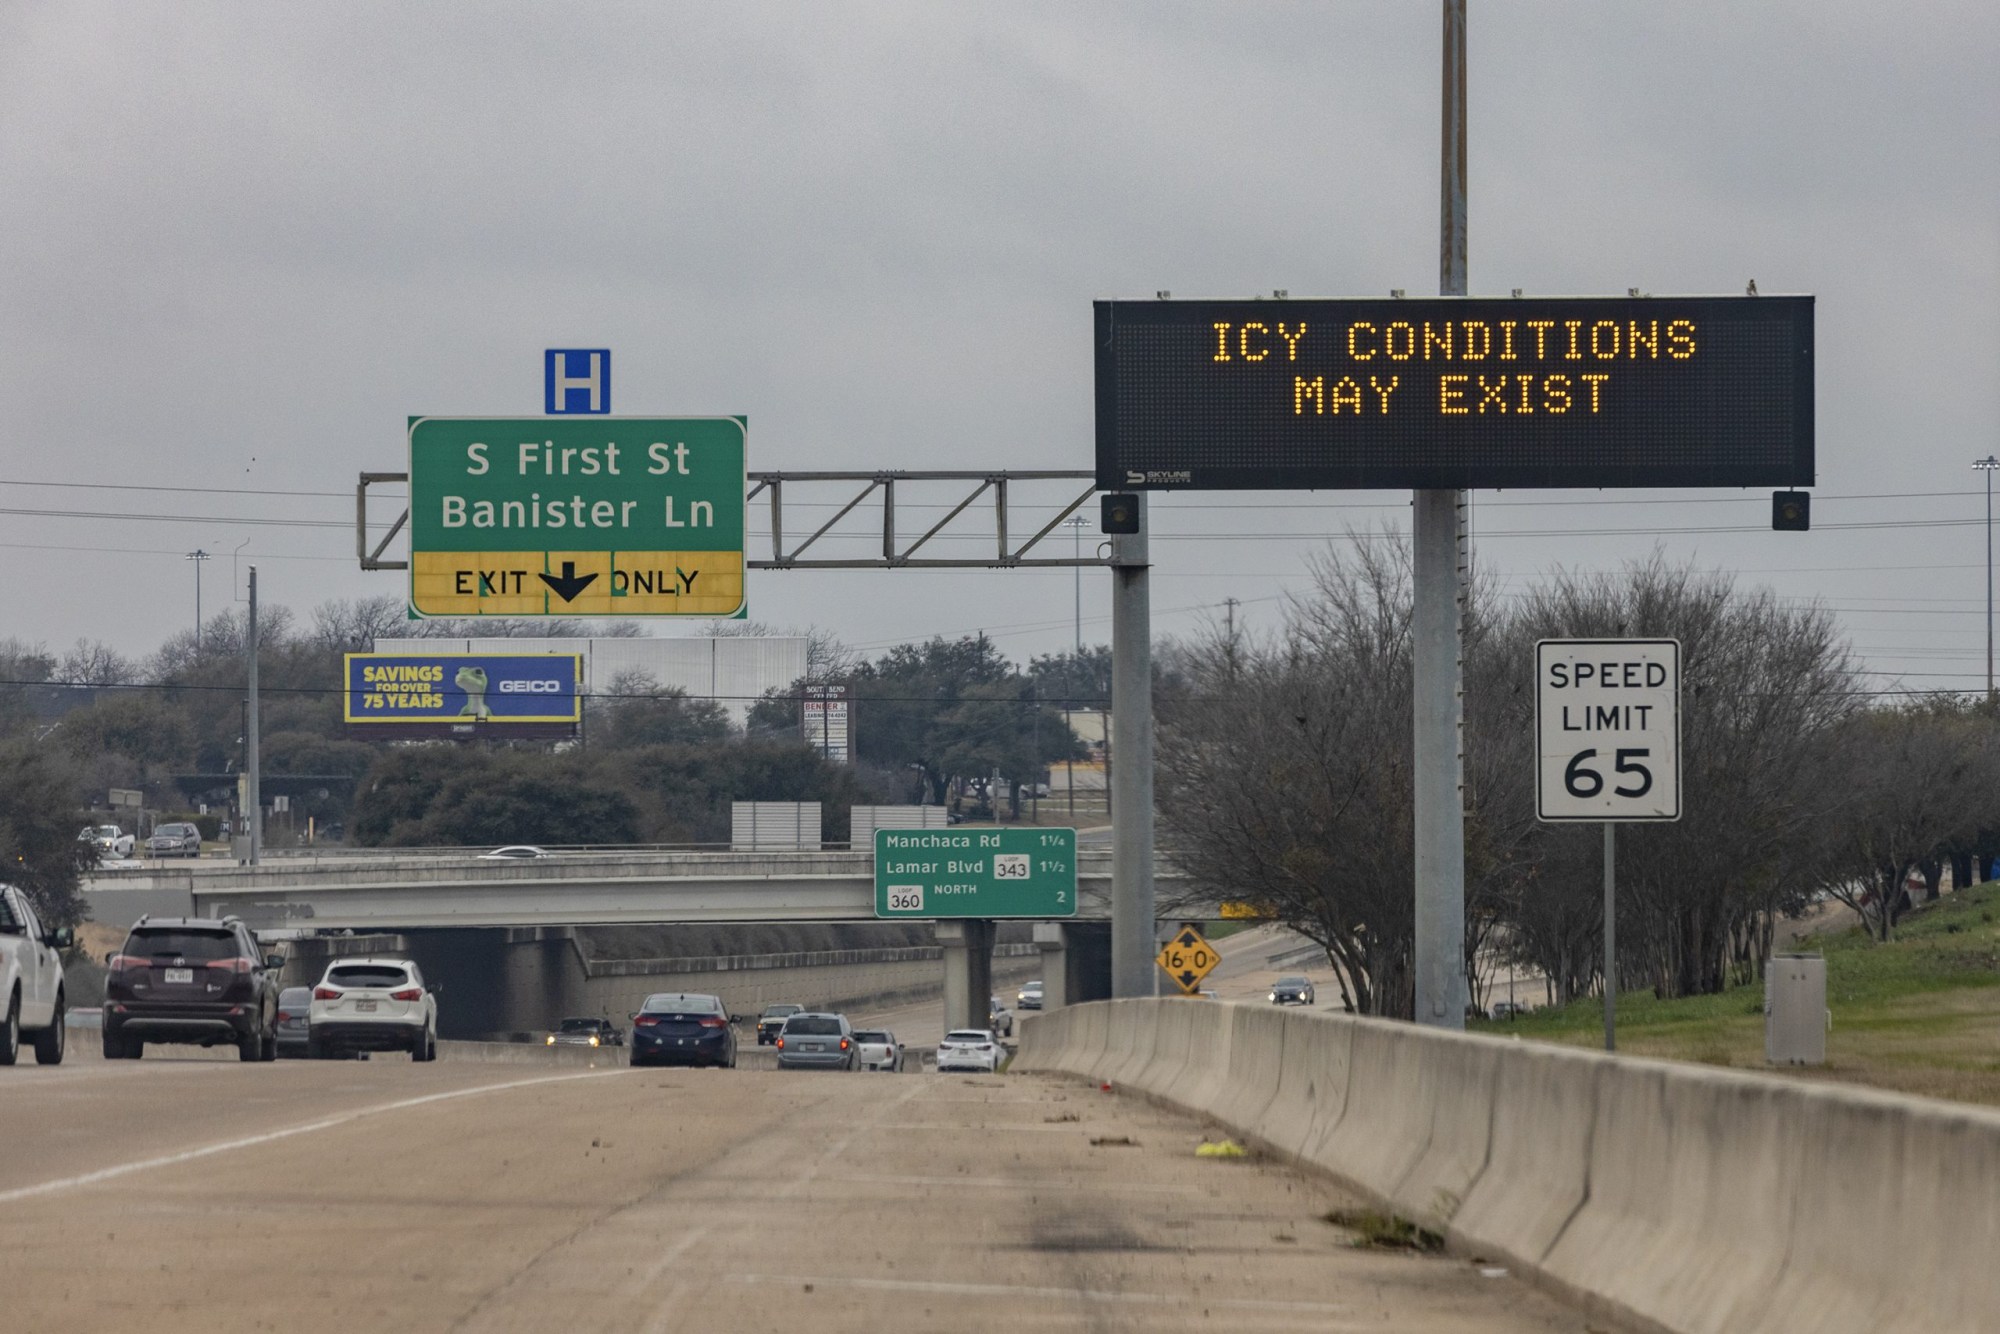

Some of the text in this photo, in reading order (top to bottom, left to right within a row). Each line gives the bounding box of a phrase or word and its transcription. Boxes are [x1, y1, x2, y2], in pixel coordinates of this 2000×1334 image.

[1213, 319, 1697, 361] ICY CONDITIONS
[554, 353, 601, 411] H
[1294, 374, 1609, 415] MAY EXIST
[466, 440, 691, 476] S First St
[442, 493, 714, 528] Banister Ln
[456, 570, 699, 594] EXIT ONLY
[363, 665, 443, 682] SAVINGS
[1550, 662, 1667, 689] SPEED
[376, 683, 431, 692] FOR OVER
[499, 680, 560, 693] GEICO
[363, 693, 444, 709] 75 YEARS
[1563, 705, 1653, 731] LIMIT
[1564, 748, 1653, 799] 65
[887, 834, 970, 848] Manchaca
[979, 834, 1001, 848] Rd
[886, 861, 938, 874] Lamar
[947, 860, 983, 874] Blvd
[997, 863, 1027, 877] 343
[891, 884, 1066, 908] 360 NORTH 2
[1164, 951, 1183, 968] 16
[1194, 951, 1206, 968] 0
